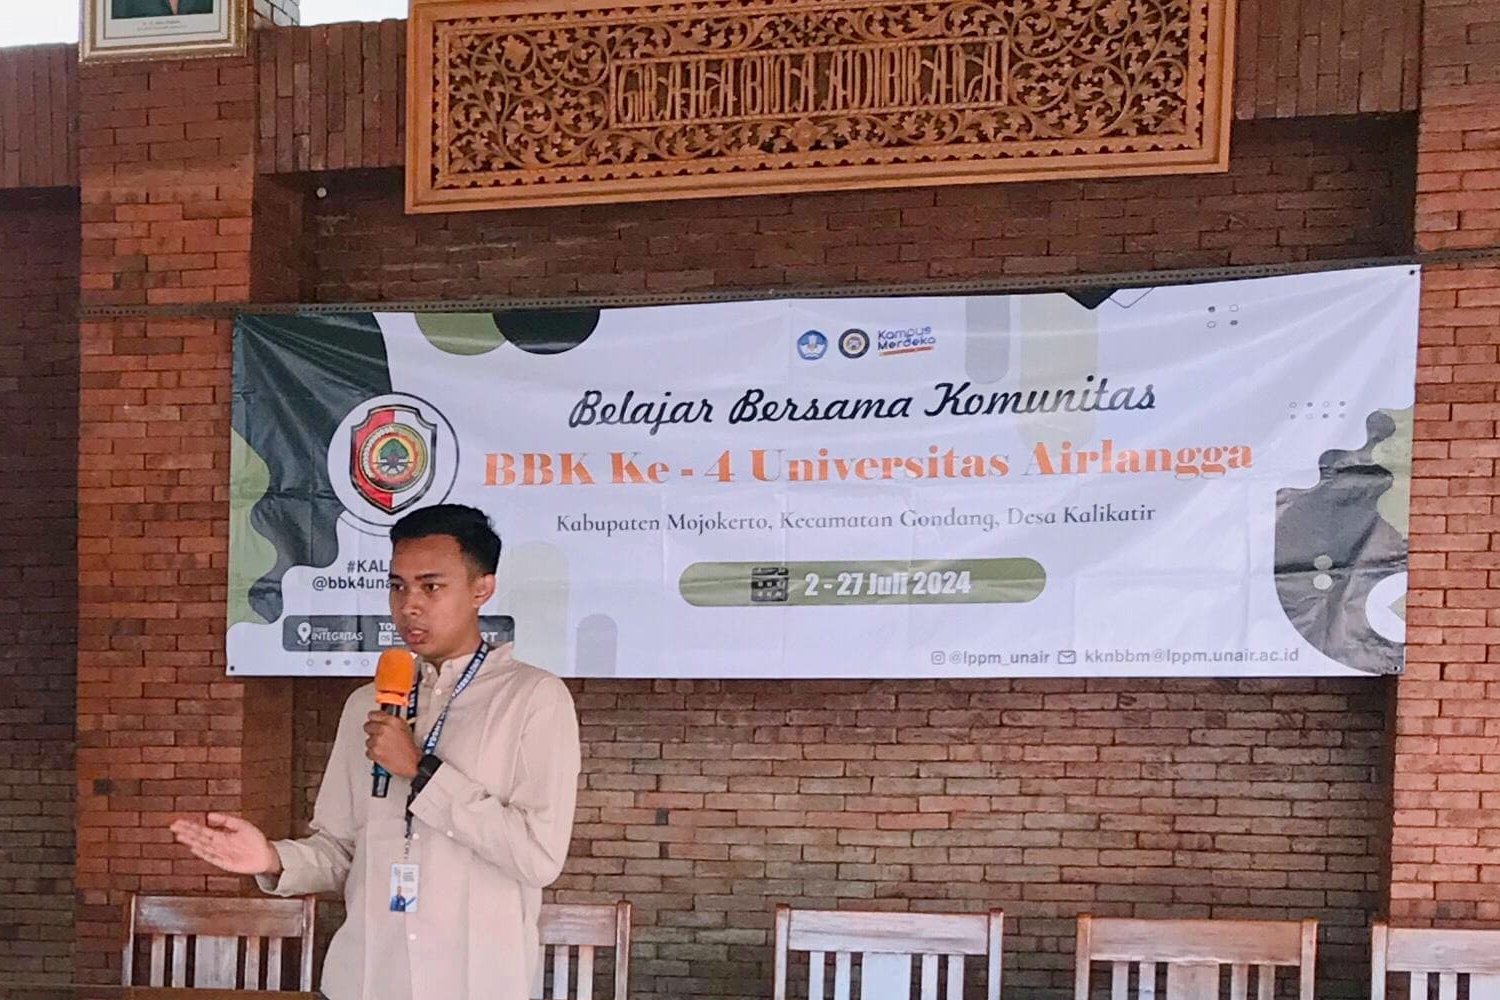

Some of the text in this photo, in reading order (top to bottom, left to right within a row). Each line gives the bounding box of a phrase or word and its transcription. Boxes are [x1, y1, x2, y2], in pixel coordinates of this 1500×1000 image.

[878, 326, 932, 341] Kampus
[877, 336, 937, 351] Merdeka
[568, 374, 1157, 435] Belajar Bersama Komunitas
[483, 438, 1253, 487] BBK Ke - 4 Universitas Airlangga
[556, 503, 1157, 537] Kabupaten Mojokerto, Kecamatan Gondang, Desa Kalikatir
[346, 559, 390, 574] #KAL
[311, 575, 393, 592] @bbk4una
[804, 572, 820, 597] 2
[836, 571, 864, 596] 27
[866, 571, 909, 595] Juli
[911, 570, 972, 595] 2024
[311, 631, 364, 641] INTEGRITAS
[950, 648, 1300, 666] @lppm_unair kknbbm@lppm.unair.ac.id
